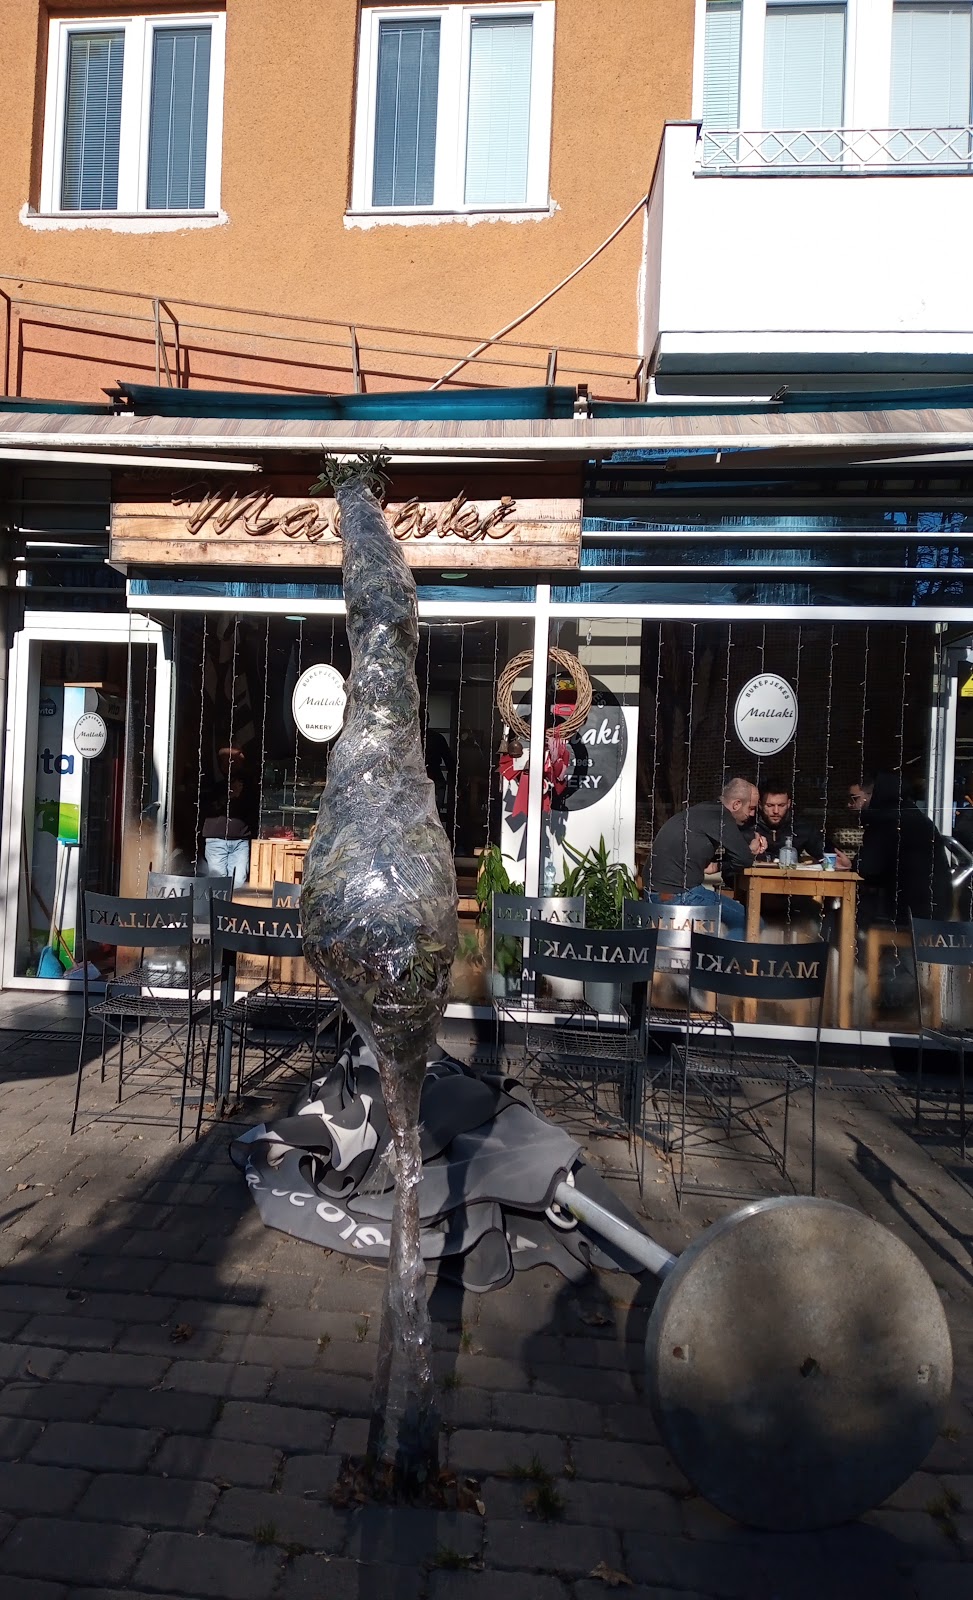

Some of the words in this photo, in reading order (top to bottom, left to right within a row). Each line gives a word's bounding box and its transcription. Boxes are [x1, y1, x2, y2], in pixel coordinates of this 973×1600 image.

[171, 488, 517, 542] Maaki
[298, 696, 344, 710] Mallaki
[741, 707, 793, 722] Mallaki
[76, 730, 104, 740] Mallaki
[748, 736, 780, 744] BAKERY
